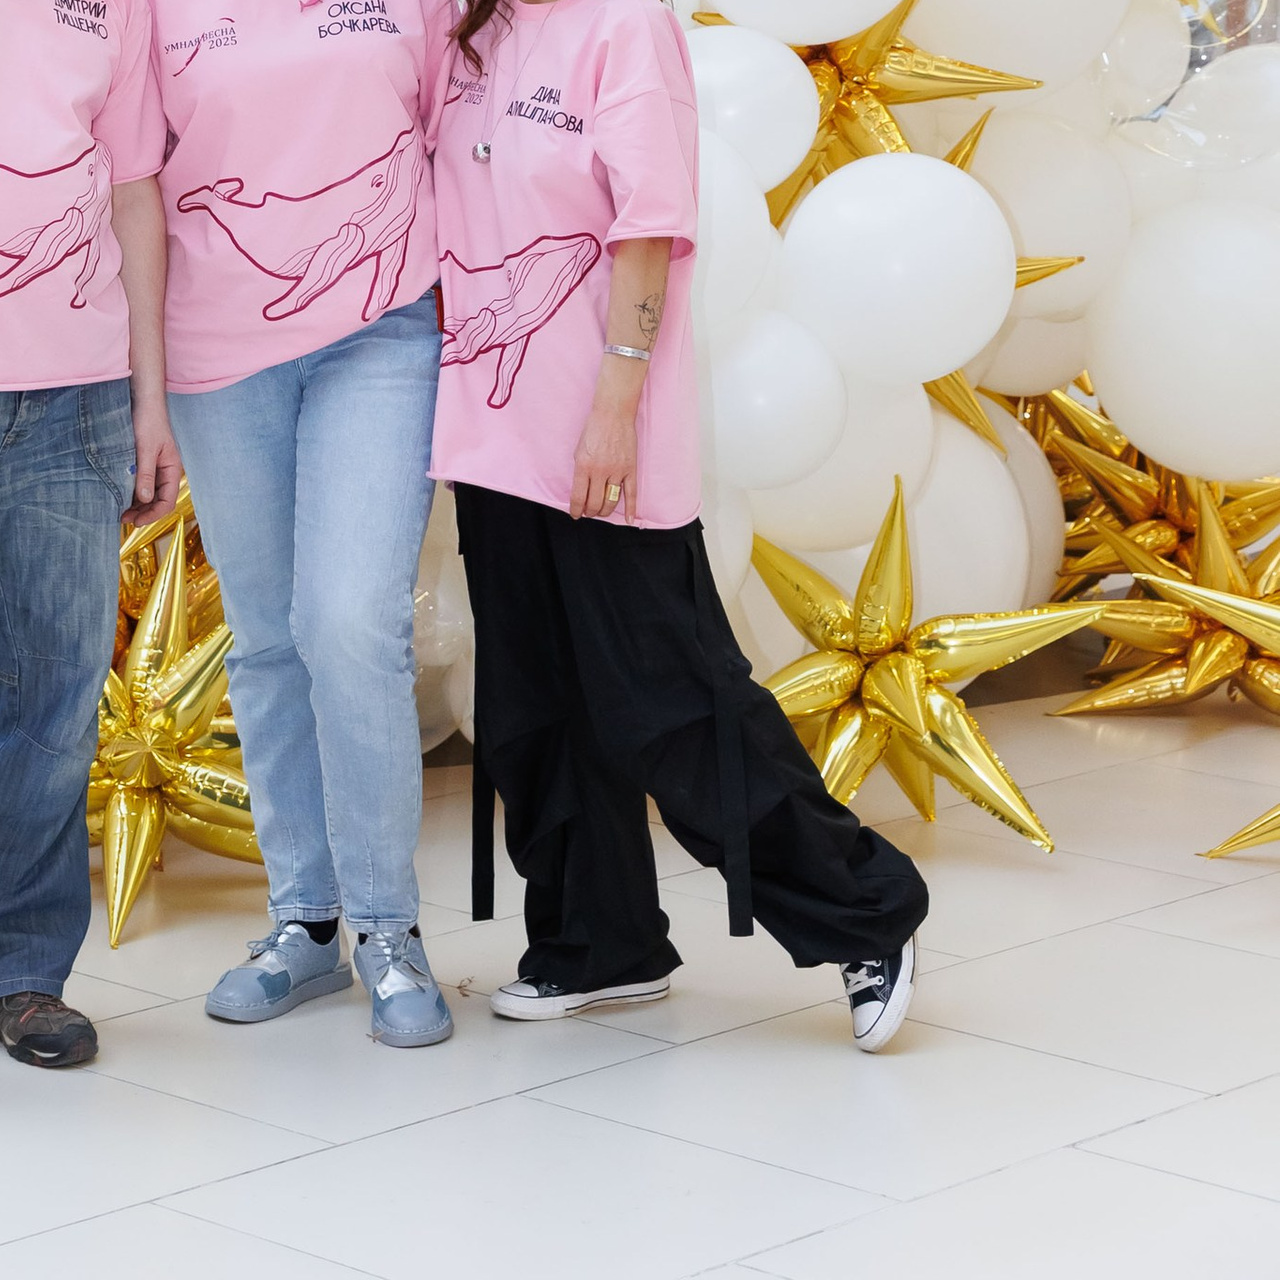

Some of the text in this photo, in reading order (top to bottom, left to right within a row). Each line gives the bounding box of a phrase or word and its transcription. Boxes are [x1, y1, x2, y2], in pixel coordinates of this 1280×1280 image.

[328, 0, 387, 18] ОКСАНА
[53, 8, 109, 40] ТИЩЕНКО
[318, 17, 401, 39] БОЧКАРЕВА
[164, 27, 236, 55] УМНАЯ ВЕСНА
[208, 36, 238, 50] 2025
[464, 92, 484, 106] 2025
[530, 85, 561, 105] ДИНА
